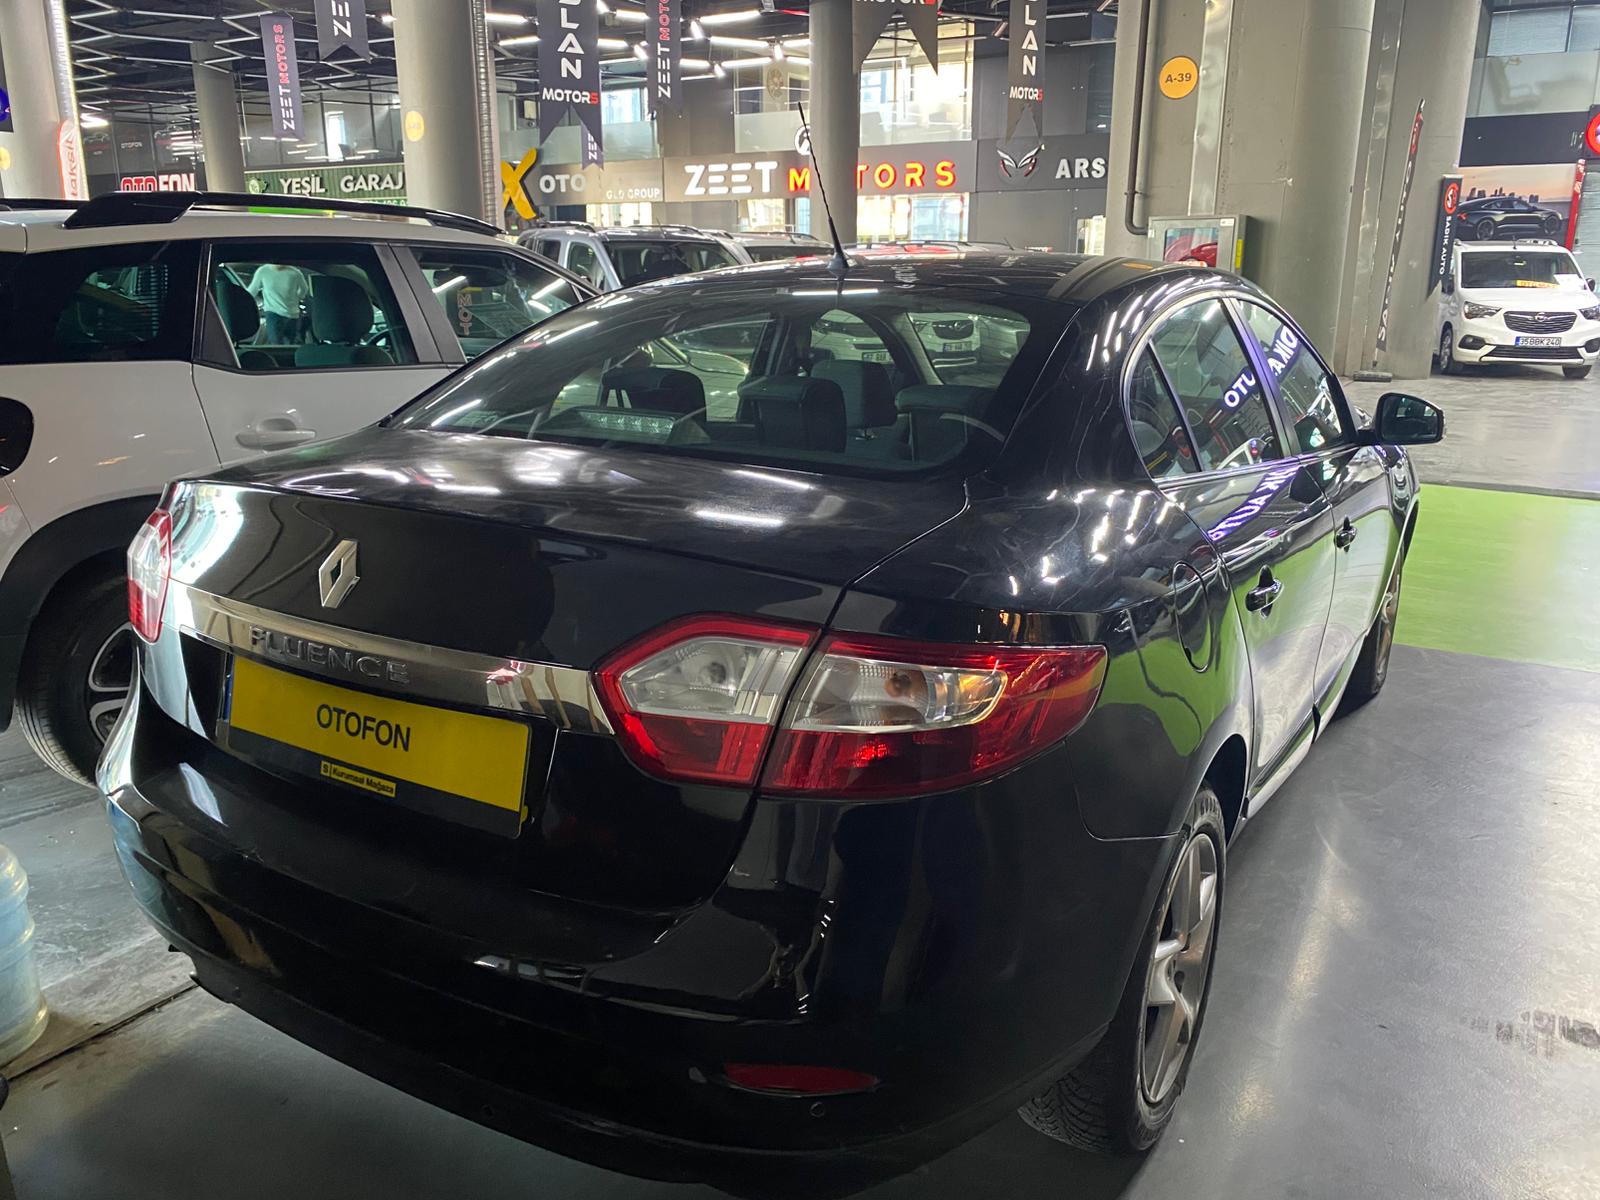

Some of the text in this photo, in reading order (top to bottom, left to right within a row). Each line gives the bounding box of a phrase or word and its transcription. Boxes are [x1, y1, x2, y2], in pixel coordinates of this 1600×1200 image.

[557, 0, 584, 79] LAN
[1021, 0, 1038, 76] LAN
[273, 24, 295, 130] ZEET MOTORS
[657, 42, 671, 98] ZEET
[1165, 73, 1192, 83] A-39
[542, 88, 599, 104] MOTORS
[1009, 86, 1043, 103] MOTORS
[280, 172, 404, 197] YEŞİL GARAJ
[539, 174, 586, 193] OTO
[684, 160, 956, 195] ZEET MTORS
[627, 188, 660, 200] GROUP
[1439, 247, 1448, 275] AUTO
[250, 624, 410, 685] FLUENCE
[316, 703, 411, 752] OTOFON
